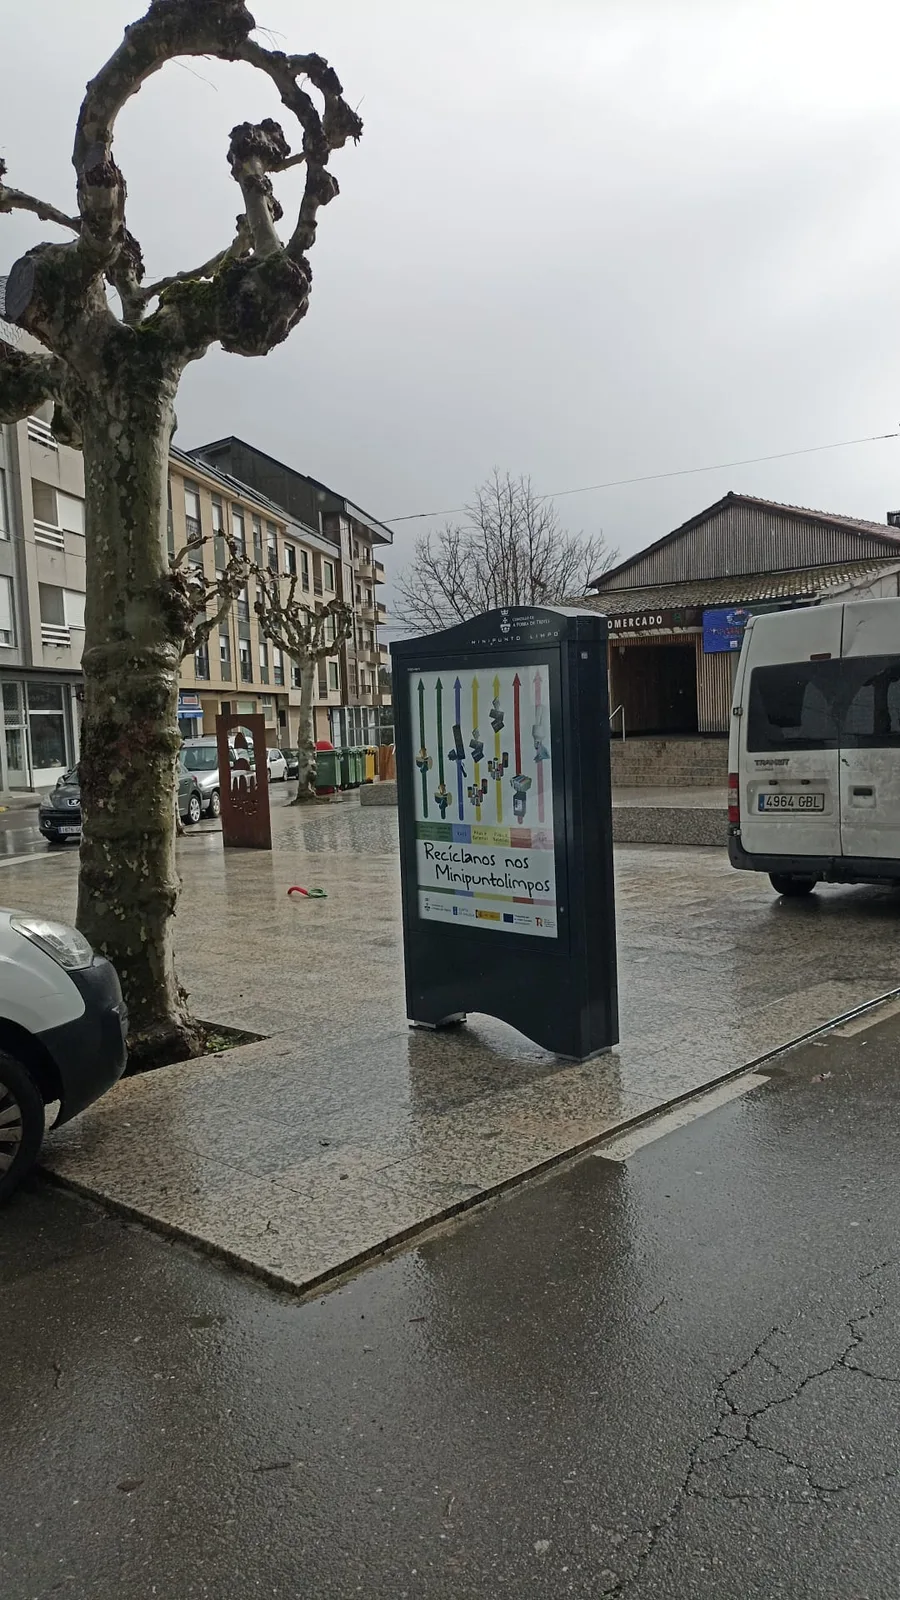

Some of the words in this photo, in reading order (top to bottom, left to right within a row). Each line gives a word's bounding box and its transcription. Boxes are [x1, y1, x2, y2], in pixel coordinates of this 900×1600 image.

[471, 636, 520, 644] MINIPUNTO
[530, 632, 558, 640] LIMPO
[766, 796, 794, 807] 4964
[798, 796, 820, 808] GBL
[424, 842, 496, 866] Recíclanos
[504, 857, 529, 868] nos
[435, 864, 550, 898] Minipuntolimpos
